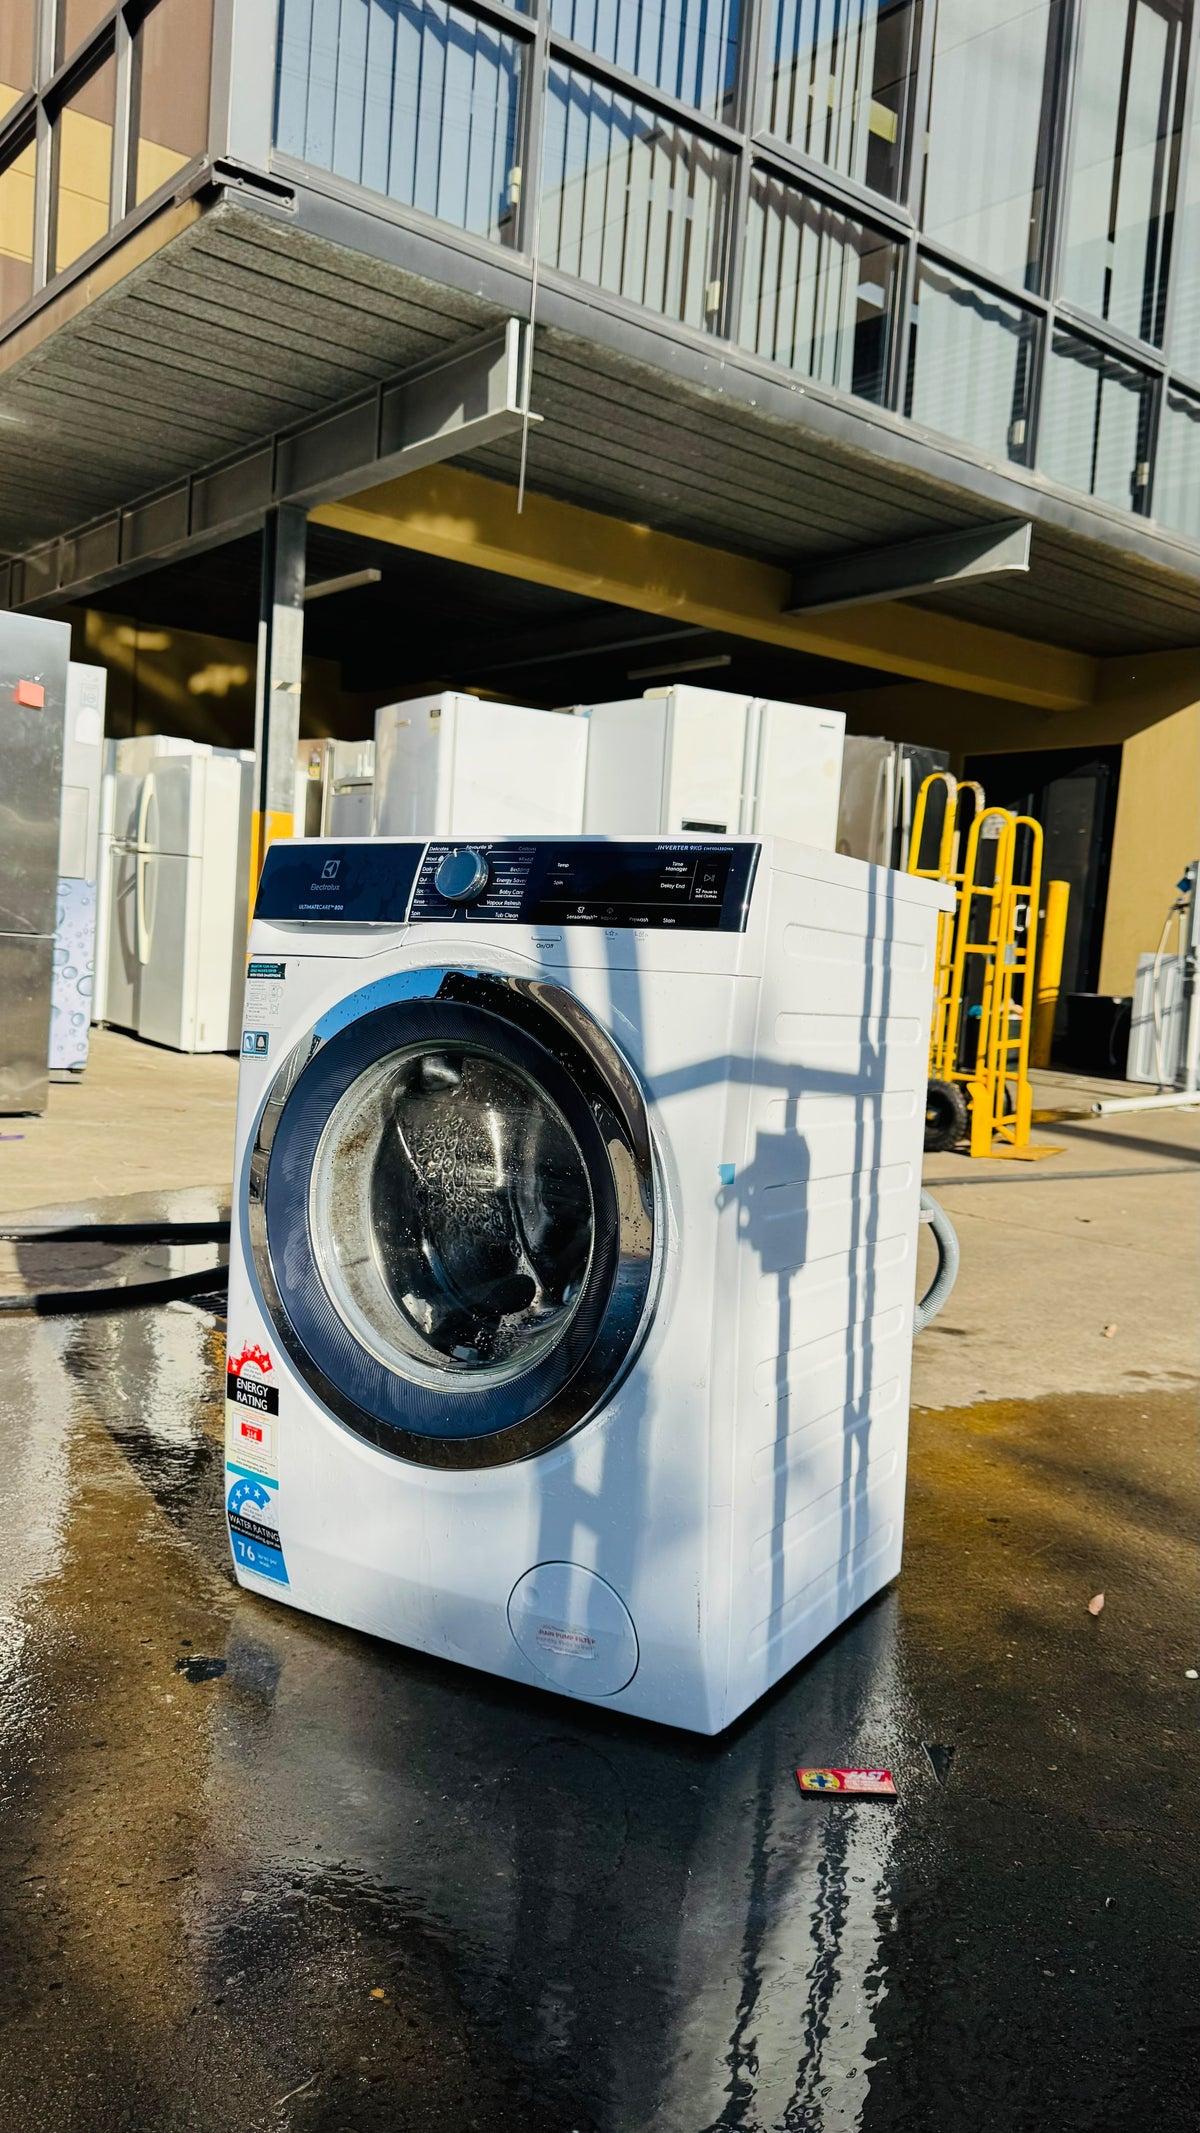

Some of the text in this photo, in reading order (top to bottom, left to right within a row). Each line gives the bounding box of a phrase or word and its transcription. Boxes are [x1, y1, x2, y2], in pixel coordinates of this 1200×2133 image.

[310, 883, 341, 891] Electrolux
[236, 1378, 269, 1397] ENERGY
[236, 1391, 268, 1410] RATING
[228, 1514, 281, 1542] WATER RATING
[237, 1541, 256, 1561] 76
[555, 1632, 575, 1641] PUMP
[848, 1771, 885, 1780] FAST
